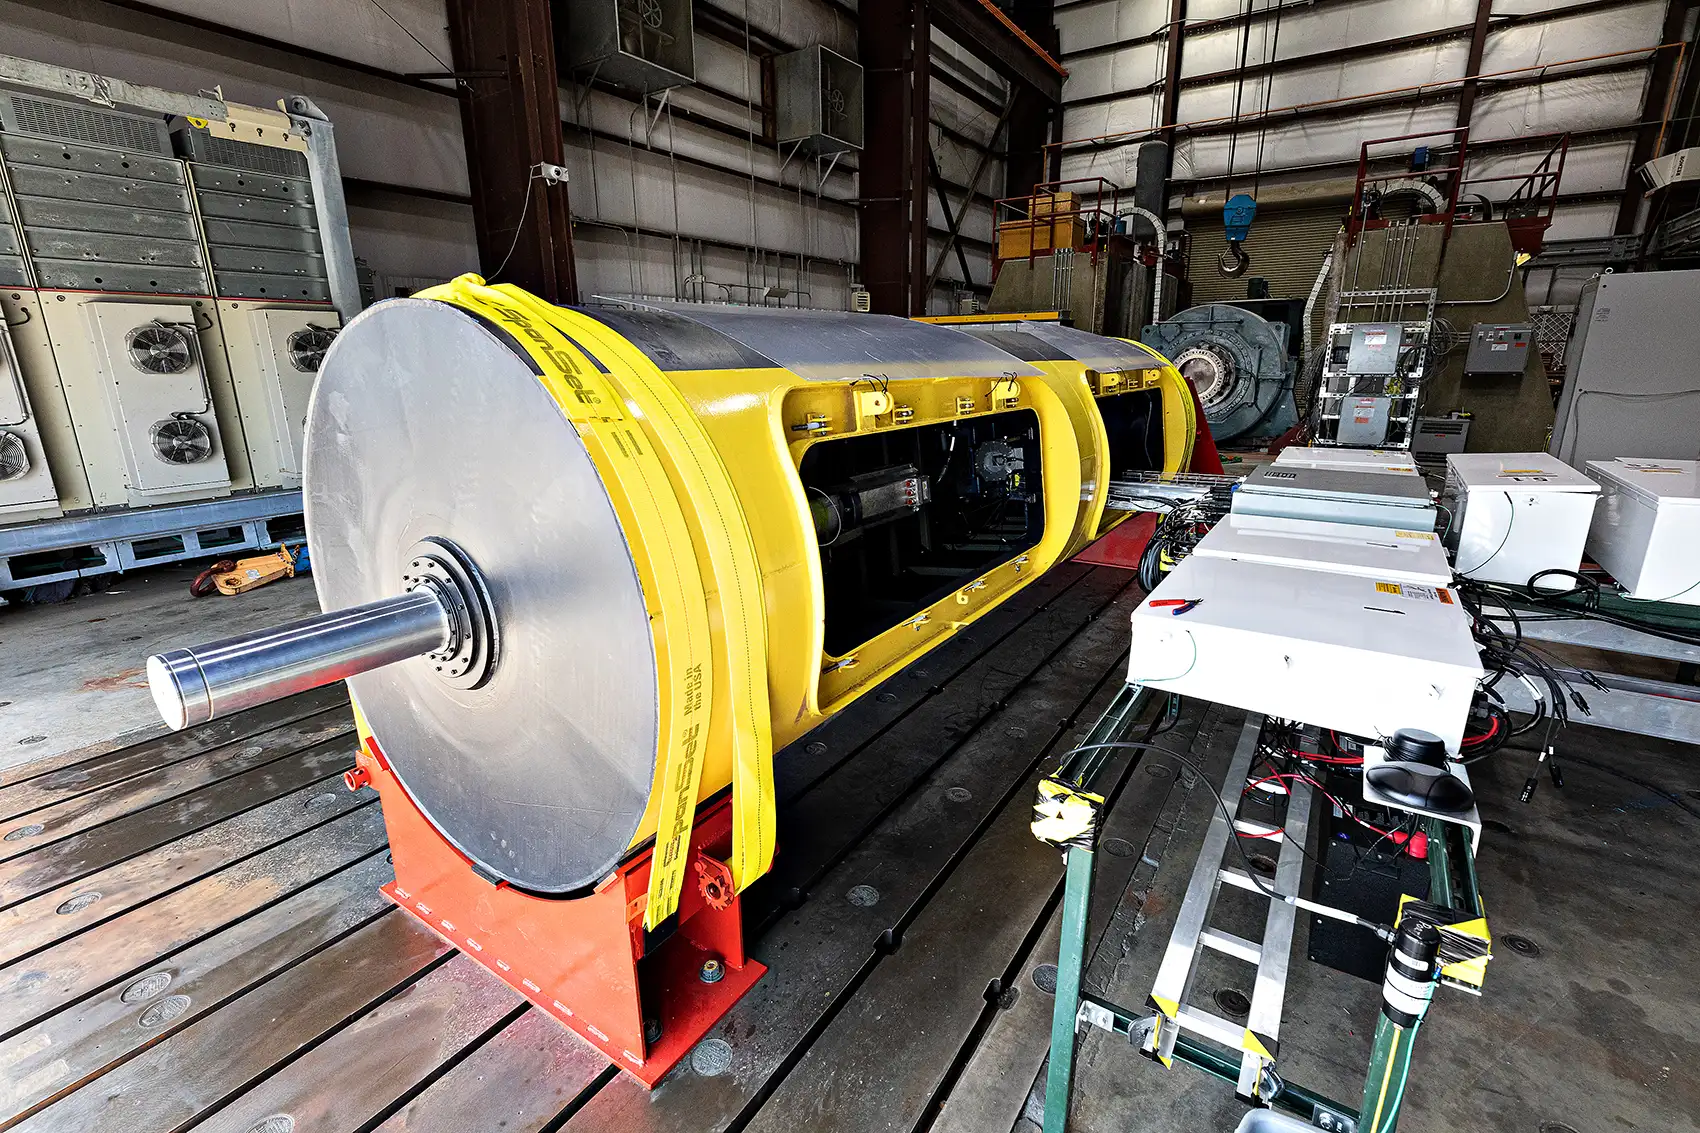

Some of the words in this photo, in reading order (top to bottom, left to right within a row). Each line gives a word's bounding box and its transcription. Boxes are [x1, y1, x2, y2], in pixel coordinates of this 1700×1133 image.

[683, 667, 693, 681] in
[693, 662, 703, 691] USA
[683, 682, 694, 717] Made
[693, 692, 703, 711] the
